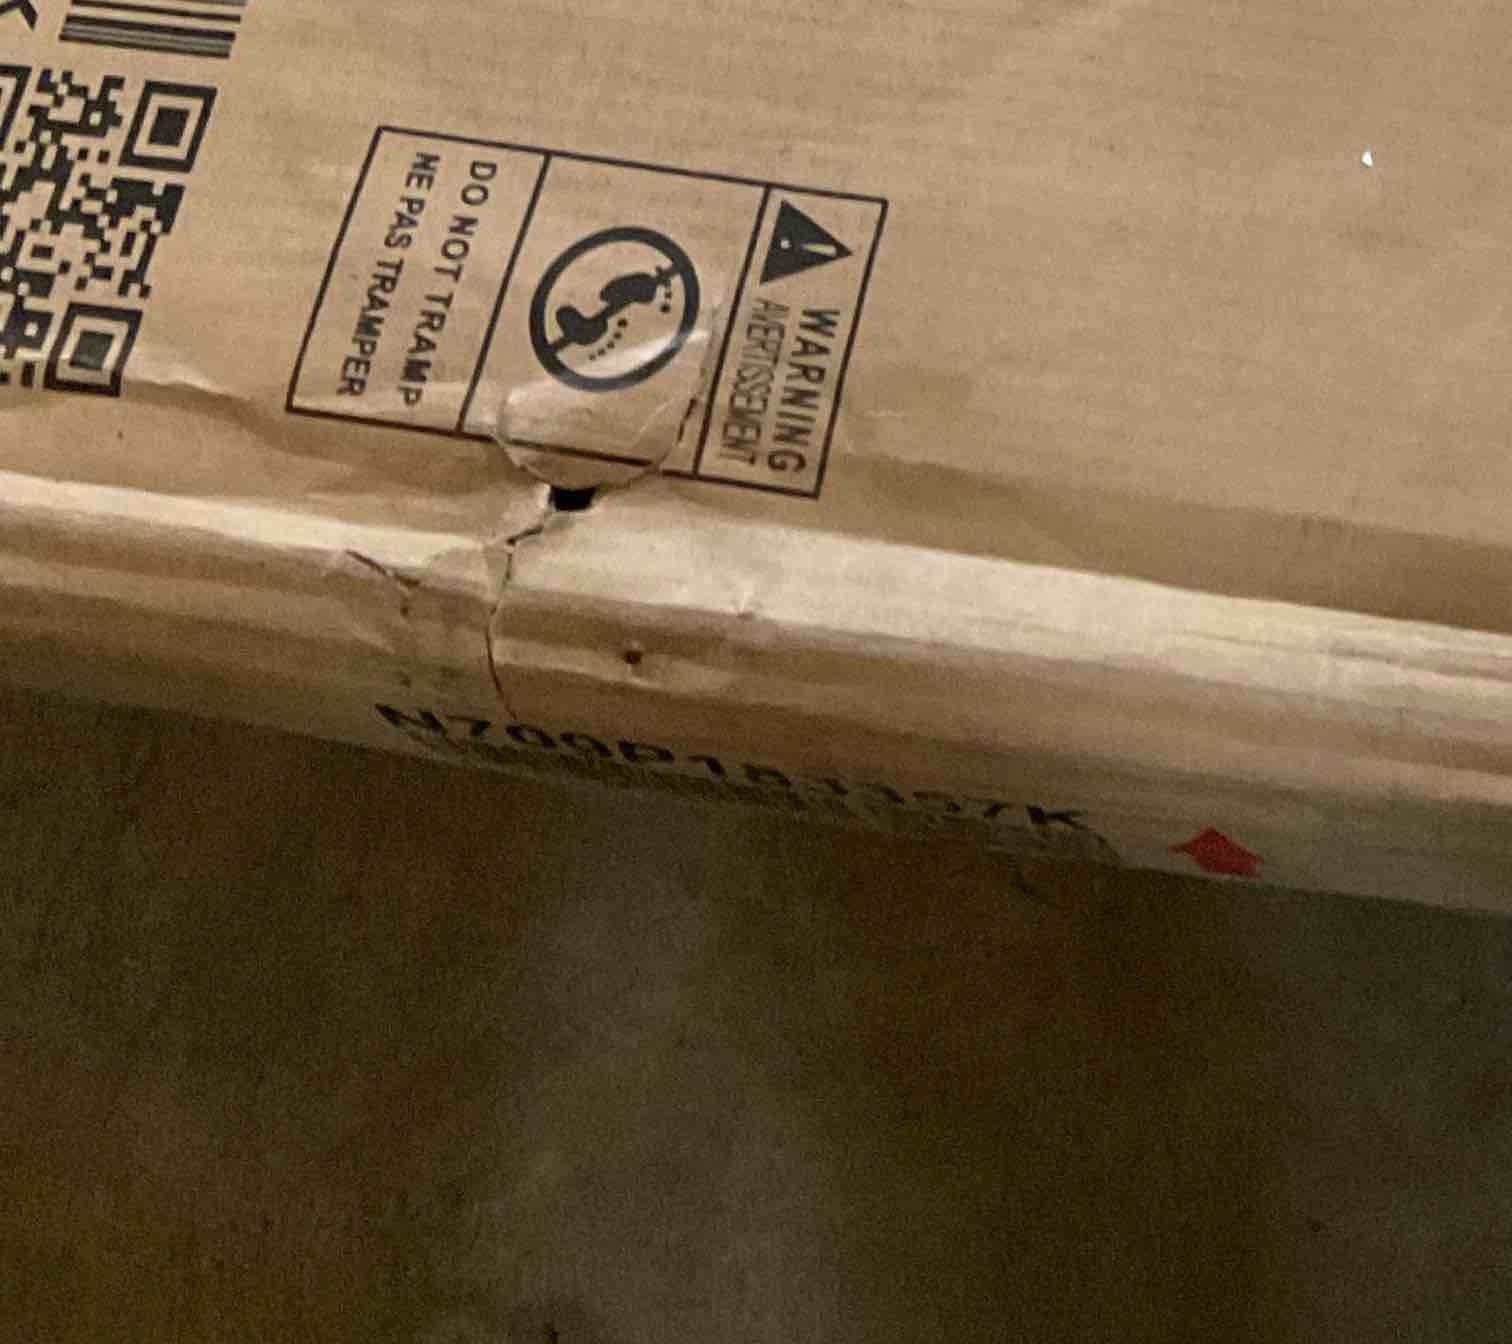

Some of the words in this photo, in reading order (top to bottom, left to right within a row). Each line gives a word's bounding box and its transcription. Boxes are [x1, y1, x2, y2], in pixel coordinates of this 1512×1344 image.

[406, 152, 441, 191] NE
[461, 160, 498, 206] DO
[384, 196, 425, 249] PAS
[435, 215, 479, 283] NOT
[338, 257, 405, 397] TRAMPER
[398, 292, 454, 406] TRAMP
[721, 296, 787, 466] AVERTISSEMENT
[767, 309, 841, 473] WARNING
